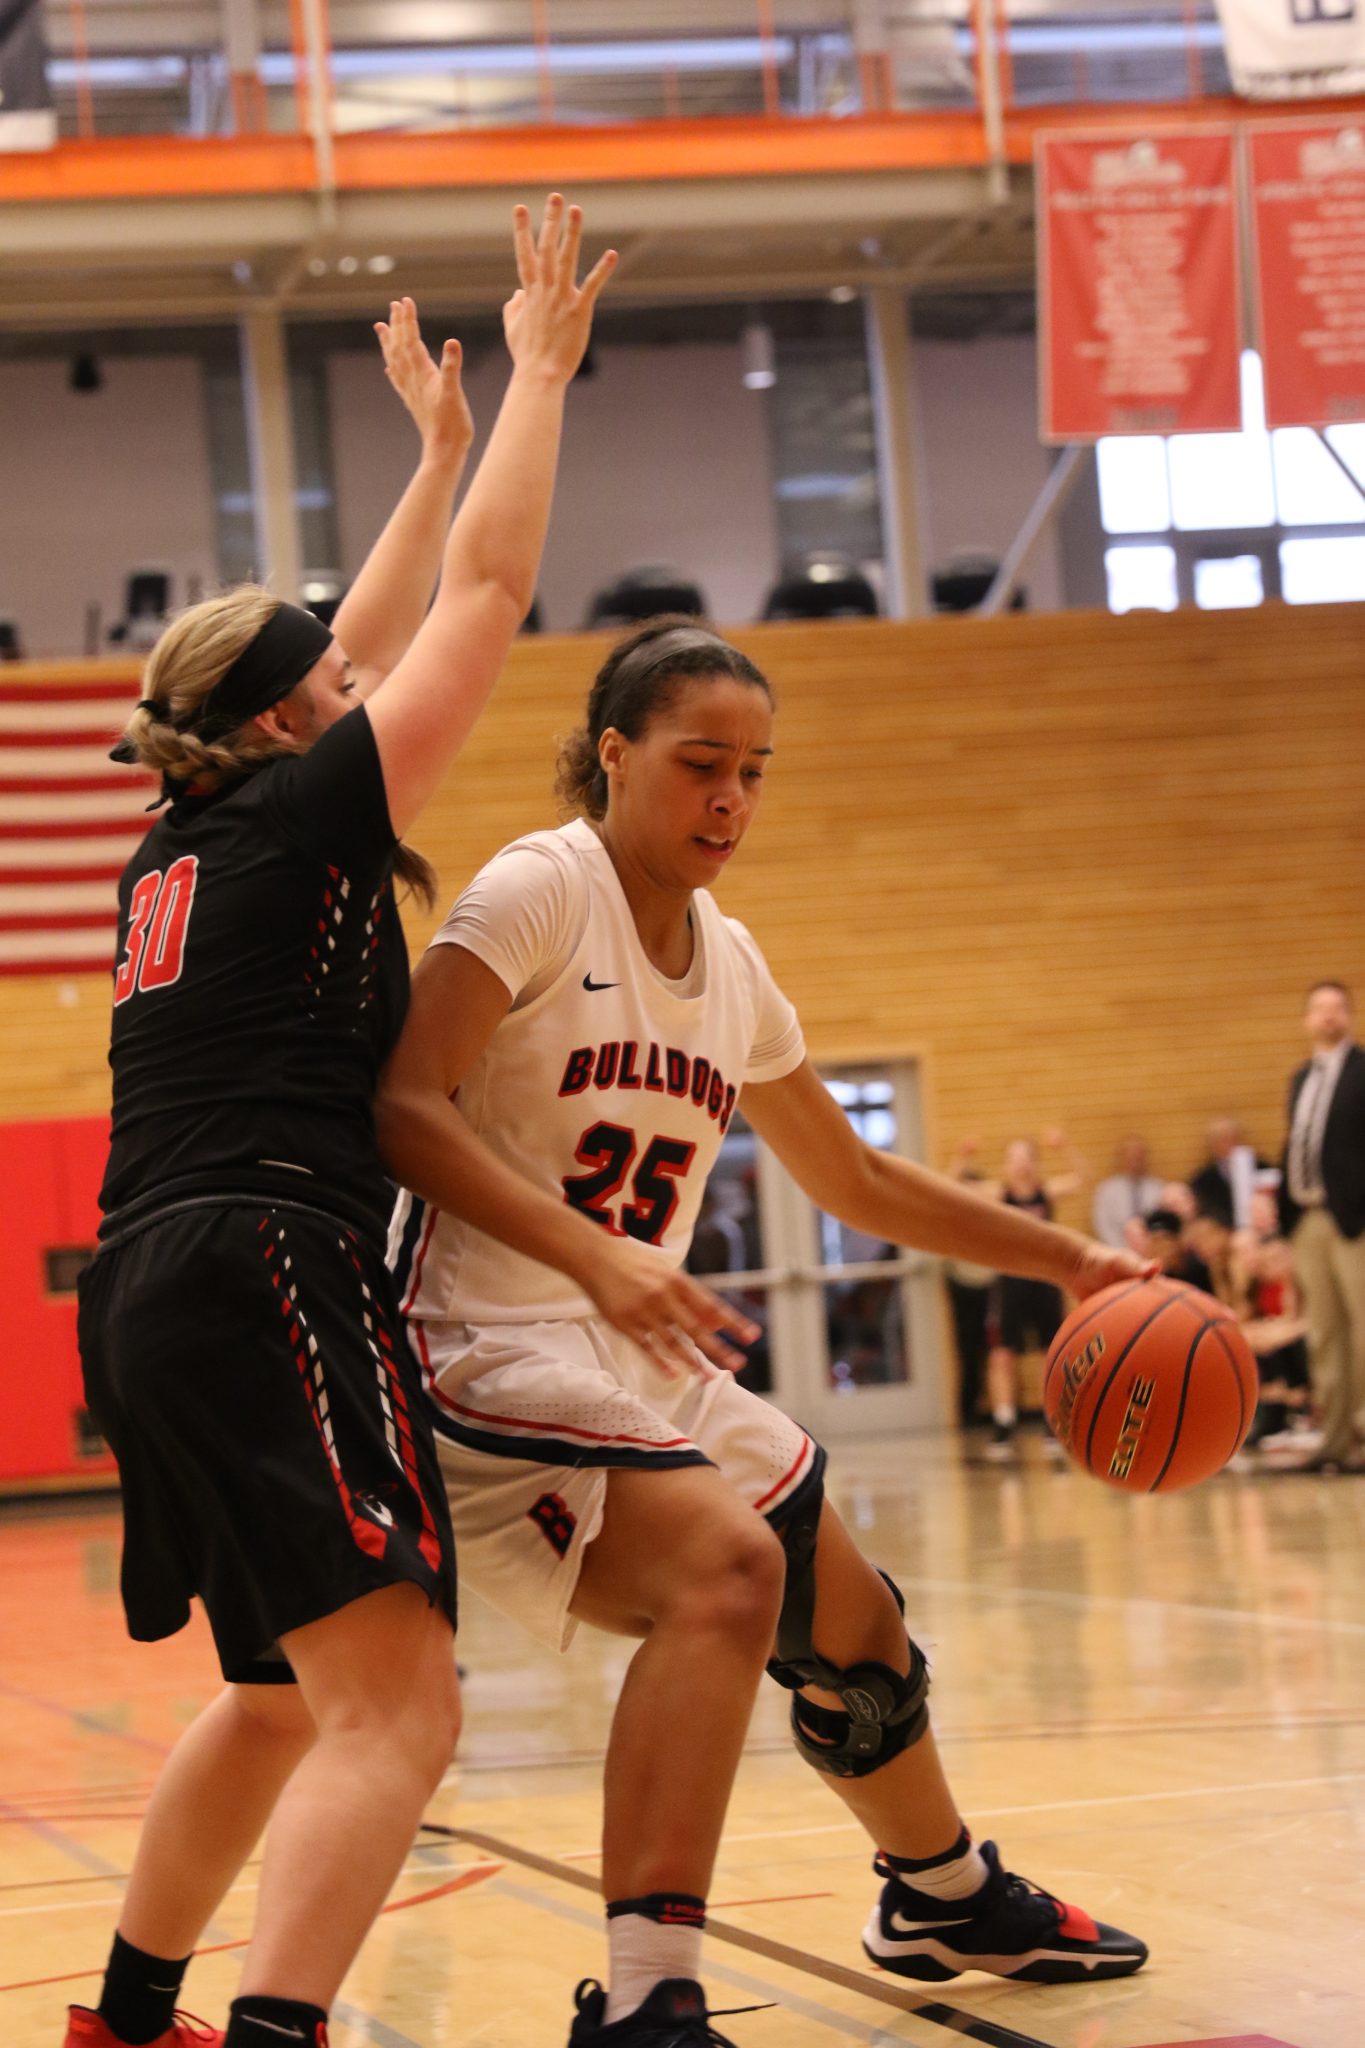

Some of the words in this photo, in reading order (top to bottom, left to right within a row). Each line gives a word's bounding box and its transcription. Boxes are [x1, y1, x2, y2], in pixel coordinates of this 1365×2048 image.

[114, 855, 199, 1007] 30
[558, 1040, 736, 1135] BULLDOGS
[561, 1120, 697, 1247] 25
[1107, 1374, 1156, 1481] ELITE
[526, 1491, 578, 1561] B
